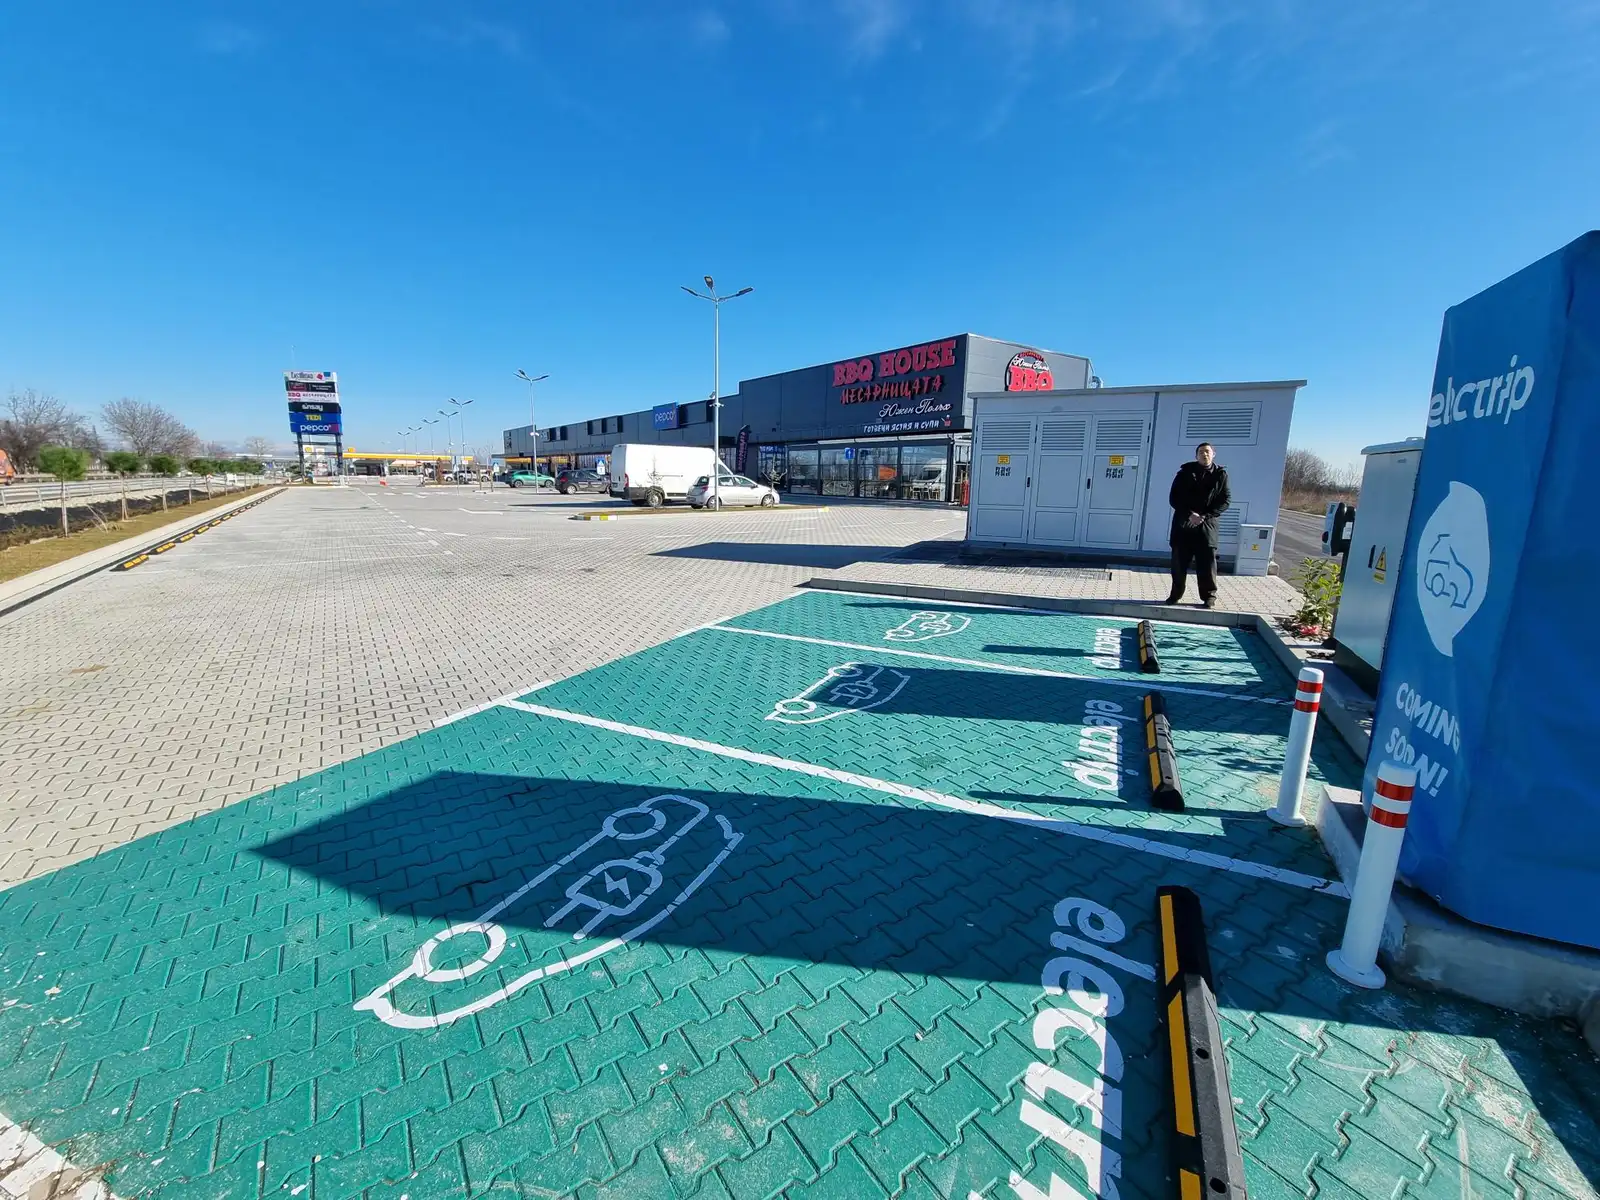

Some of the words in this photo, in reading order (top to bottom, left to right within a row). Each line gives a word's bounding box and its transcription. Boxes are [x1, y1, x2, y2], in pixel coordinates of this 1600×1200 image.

[833, 358, 874, 387] BBQ
[879, 340, 957, 378] HOUSE
[1396, 682, 1460, 755] COMING
